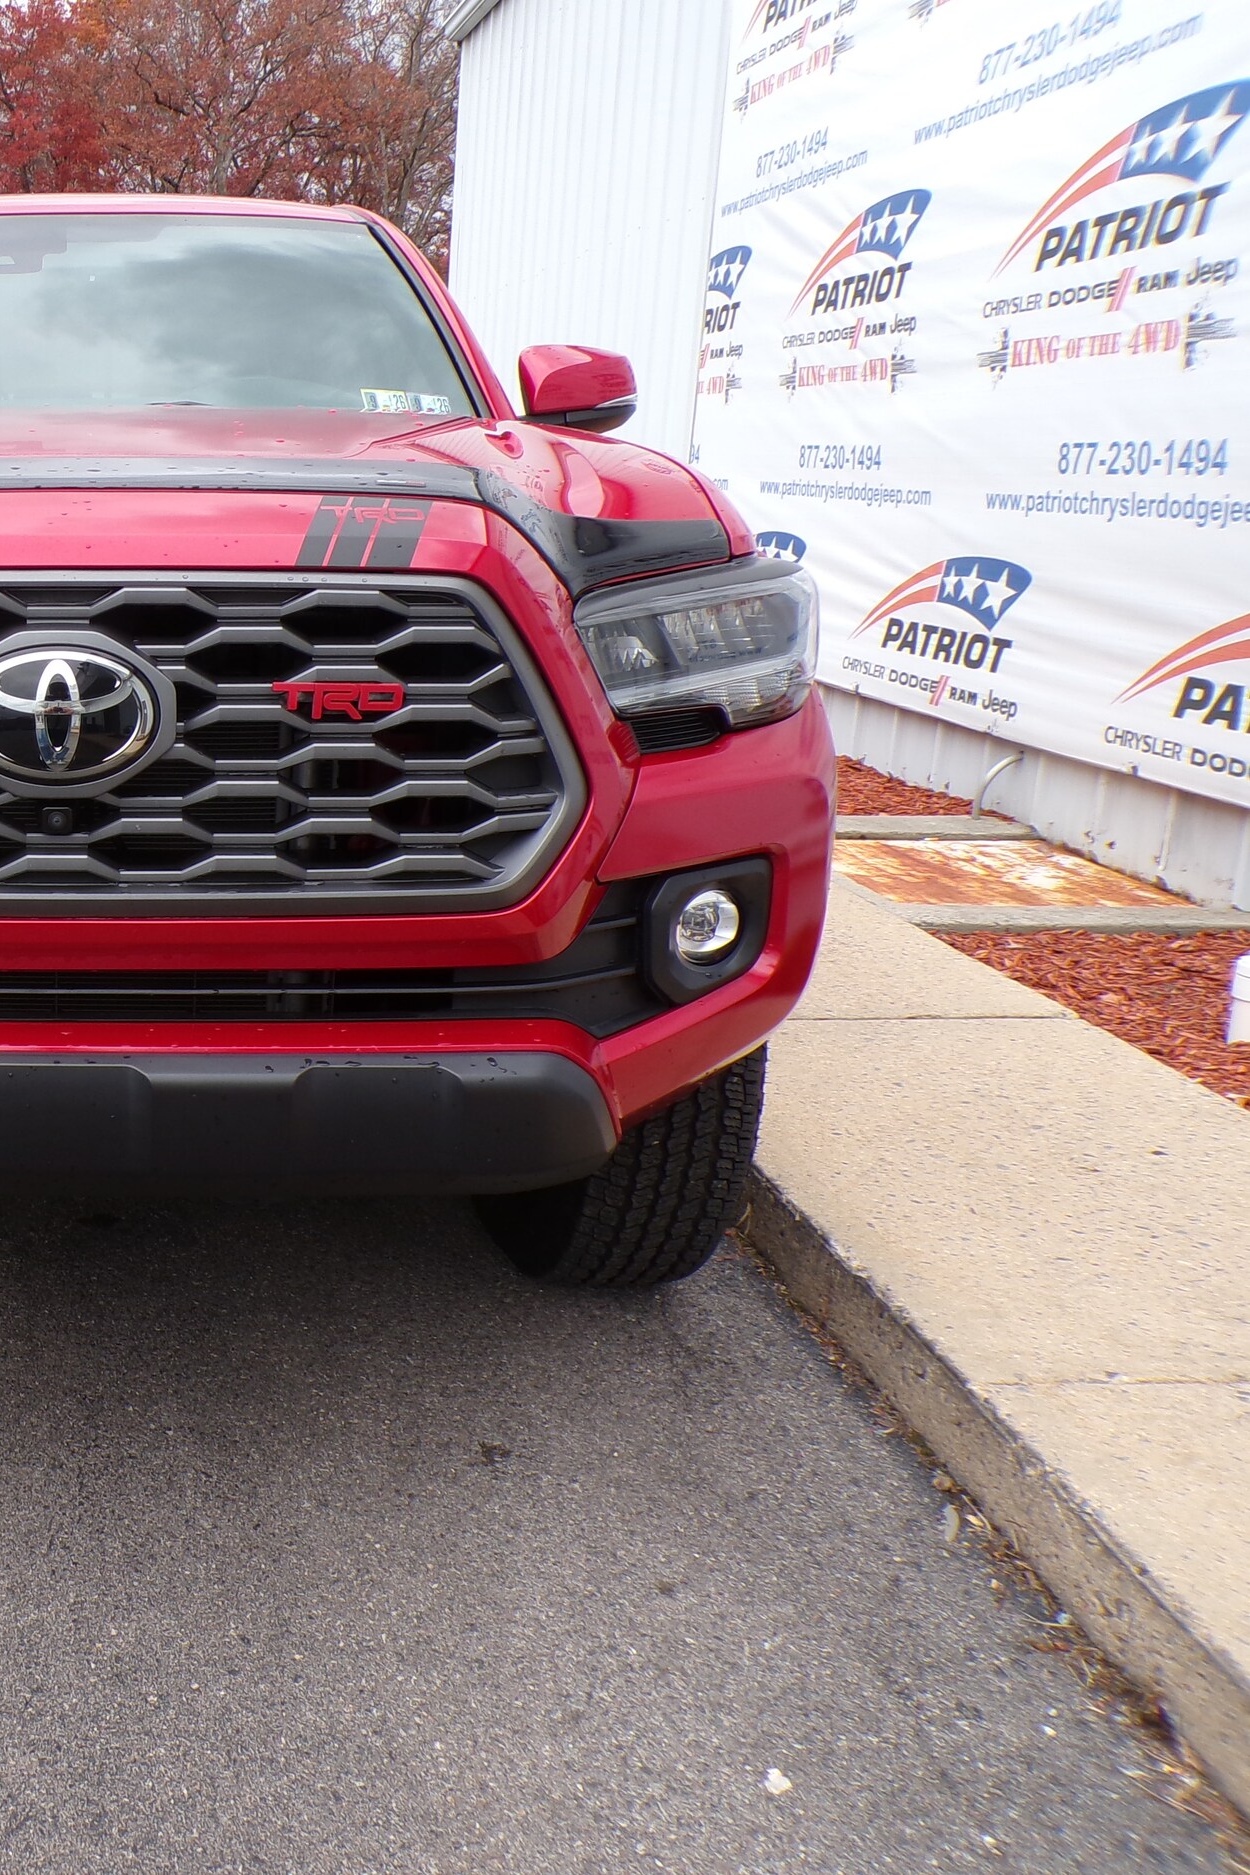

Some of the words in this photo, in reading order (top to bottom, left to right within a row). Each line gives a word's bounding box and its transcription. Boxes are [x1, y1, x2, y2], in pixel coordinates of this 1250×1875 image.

[769, 25, 805, 57] DODGE
[811, 12, 832, 33] RAM
[977, 0, 1123, 85] 877-230-1494
[750, 74, 775, 105] KING
[777, 72, 787, 89] OF
[787, 60, 805, 83] THE
[806, 44, 831, 76] 4WD
[913, 11, 1205, 145] www.patriotchryslerdodgejeep.com
[756, 126, 829, 178] 877-230-1494
[721, 150, 868, 218] www.patriotchryslerdodgejeep.com
[1032, 180, 1231, 273] PATRIOT
[810, 261, 913, 316] PATRIOT
[982, 293, 1042, 318] CHRYSLER
[1047, 278, 1120, 308] DODGE
[1136, 269, 1180, 294] RAM
[1185, 256, 1239, 287] Jeep
[703, 301, 741, 334] RIOT
[782, 332, 815, 349] CHRYSLER
[818, 325, 857, 345] DODGE
[864, 321, 886, 338] RAM
[890, 313, 917, 336] Jeep
[725, 340, 743, 360] Jeep
[1010, 335, 1060, 367] KING
[1066, 337, 1084, 359] OF
[1088, 331, 1122, 356] THE
[1127, 318, 1181, 355] 4WD
[706, 375, 725, 395] 4WD
[798, 365, 825, 387] KING
[827, 367, 840, 383] OF
[840, 364, 858, 382] THE
[861, 358, 888, 383] 4WD
[798, 444, 882, 470] 877-230-1494
[1057, 437, 1229, 475] 877-230-1494
[320, 505, 426, 524] TRD
[759, 477, 932, 508] www.patriotchryslerdodgejeep.com
[986, 489, 1250, 529] www.patriotchryslerdodgeje
[881, 617, 1014, 674] PATRIOT
[272, 681, 403, 720] TRD
[842, 656, 885, 679] CHRYSLER
[888, 669, 940, 694] DODGE
[948, 686, 978, 706] RAM
[981, 689, 1018, 721] Jeep
[1104, 726, 1183, 761] CHRYSLER
[1190, 748, 1250, 781] DOD
